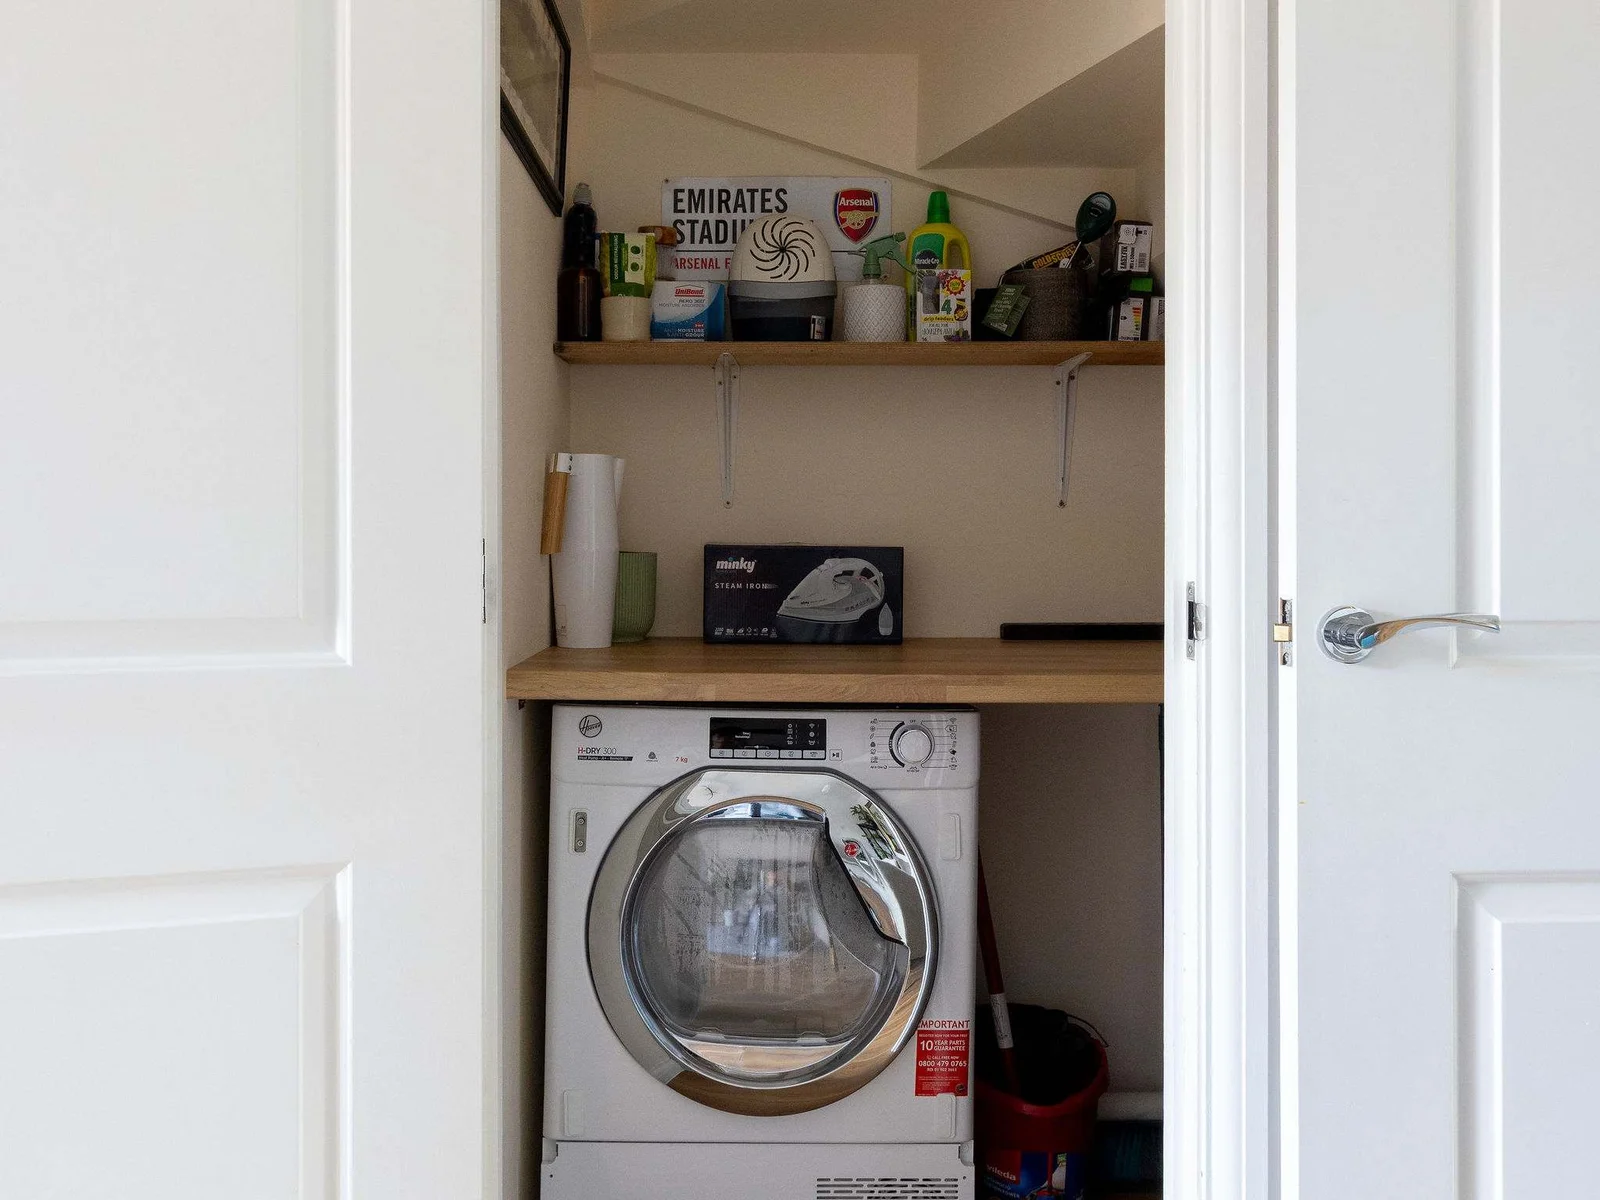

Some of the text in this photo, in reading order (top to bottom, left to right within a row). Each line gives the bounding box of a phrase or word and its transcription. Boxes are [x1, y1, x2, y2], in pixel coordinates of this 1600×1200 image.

[673, 188, 788, 214] EMIRATES
[839, 197, 874, 206] Arsenal
[941, 299, 952, 314] 4
[716, 557, 754, 573] minky
[920, 1040, 934, 1051] 10
